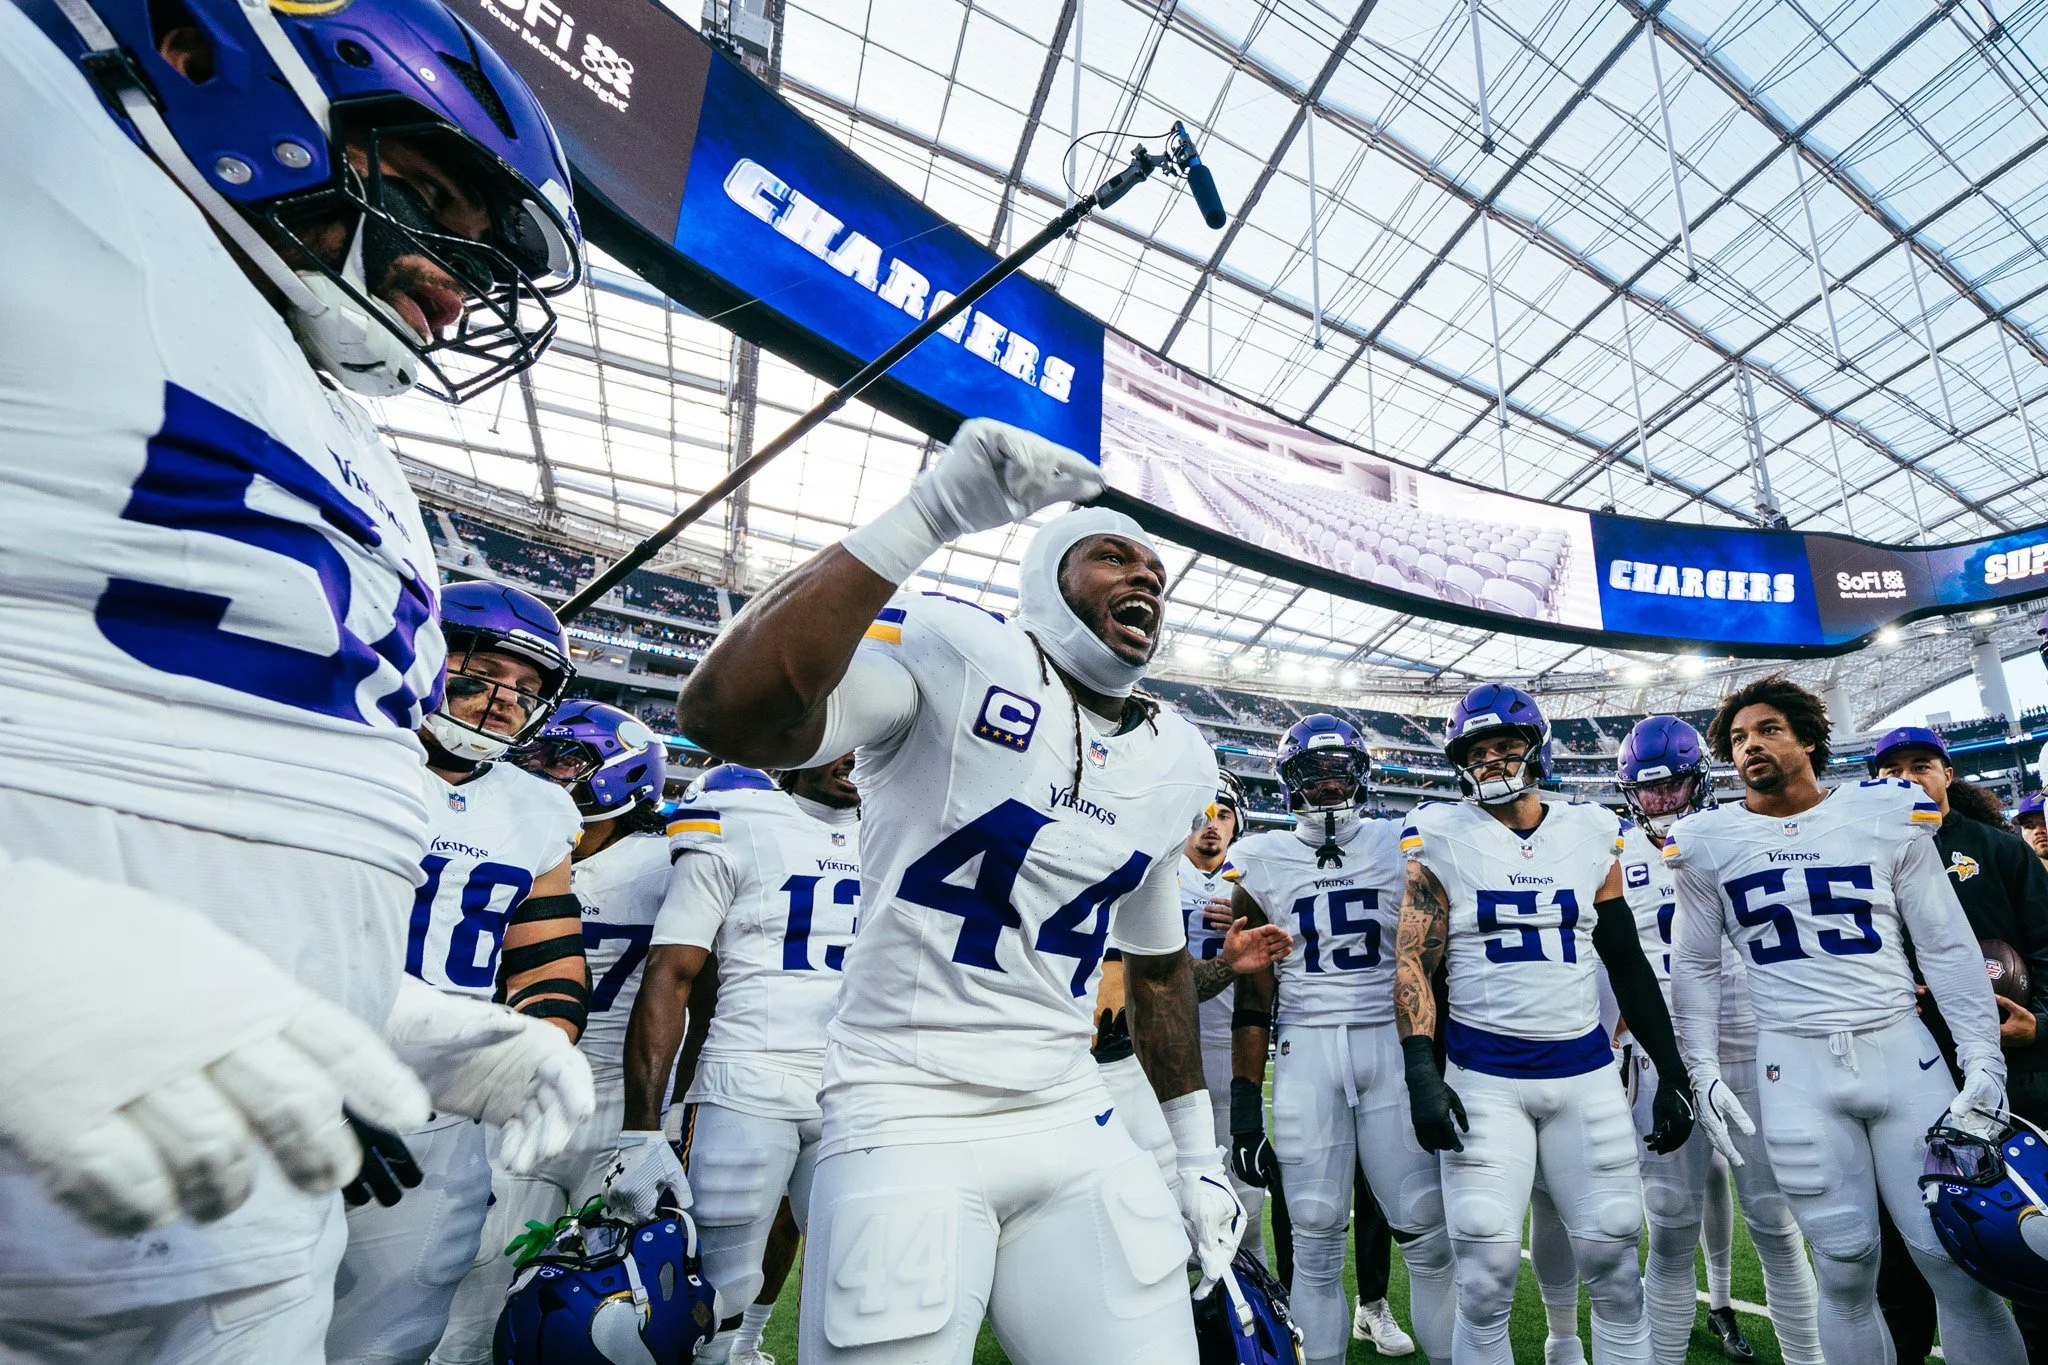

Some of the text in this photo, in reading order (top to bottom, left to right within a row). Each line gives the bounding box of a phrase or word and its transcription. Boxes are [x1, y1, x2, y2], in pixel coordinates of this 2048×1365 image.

[521, 27, 581, 80] Money
[583, 74, 629, 112] Right
[724, 158, 1075, 403] CHARGERS
[1609, 559, 1795, 603] CHARGERS
[1837, 571, 1881, 590] SoFi
[984, 691, 1035, 735] C
[895, 798, 1153, 998] 44
[1627, 865, 1647, 883] C
[1724, 865, 1882, 965] 55
[405, 854, 534, 988] 18
[1291, 888, 1381, 973] 15
[1476, 889, 1580, 964] 51
